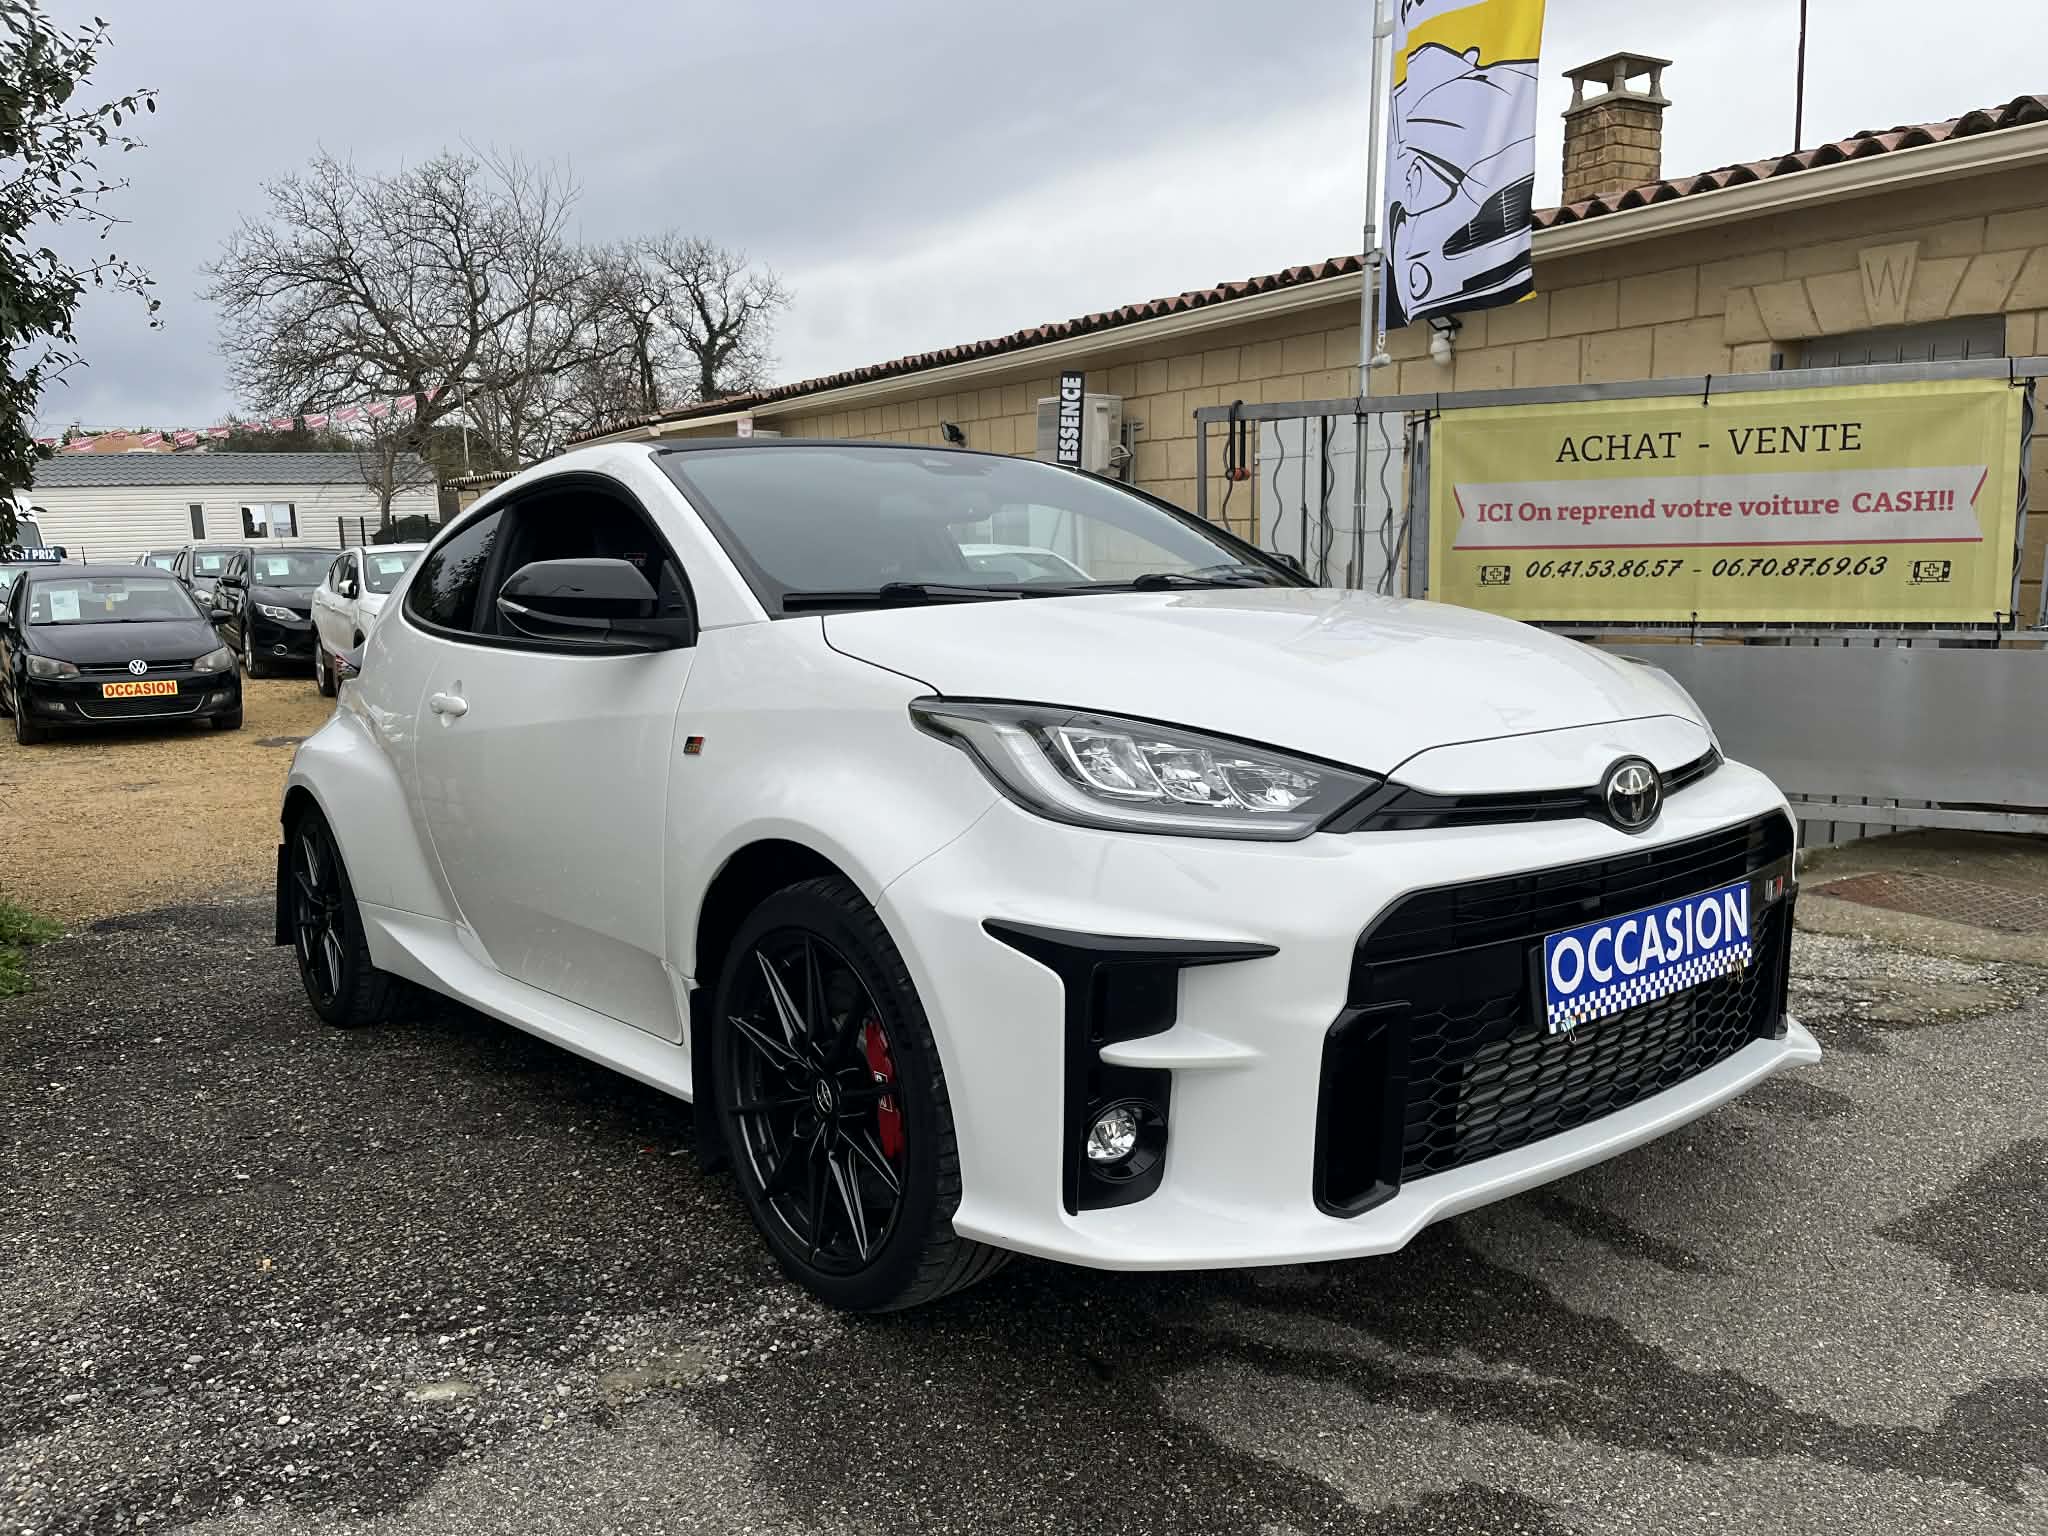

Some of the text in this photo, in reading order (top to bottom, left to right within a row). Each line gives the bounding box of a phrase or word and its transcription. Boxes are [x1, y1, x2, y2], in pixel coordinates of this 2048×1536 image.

[1864, 255, 1909, 306] W
[1058, 376, 1082, 463] ESSENCE
[1555, 431, 1682, 463] ACHAT
[1727, 422, 1863, 456] VENTE
[1477, 490, 1955, 525] ICI On reprend votre voiture CASH!!
[32, 549, 56, 560] PRIX
[1525, 559, 1684, 579] 06.41.53.86.57
[1711, 556, 1888, 577] 06.70.87.69.63
[105, 681, 176, 697] OCCASION
[1550, 887, 1748, 995] OCCASION
